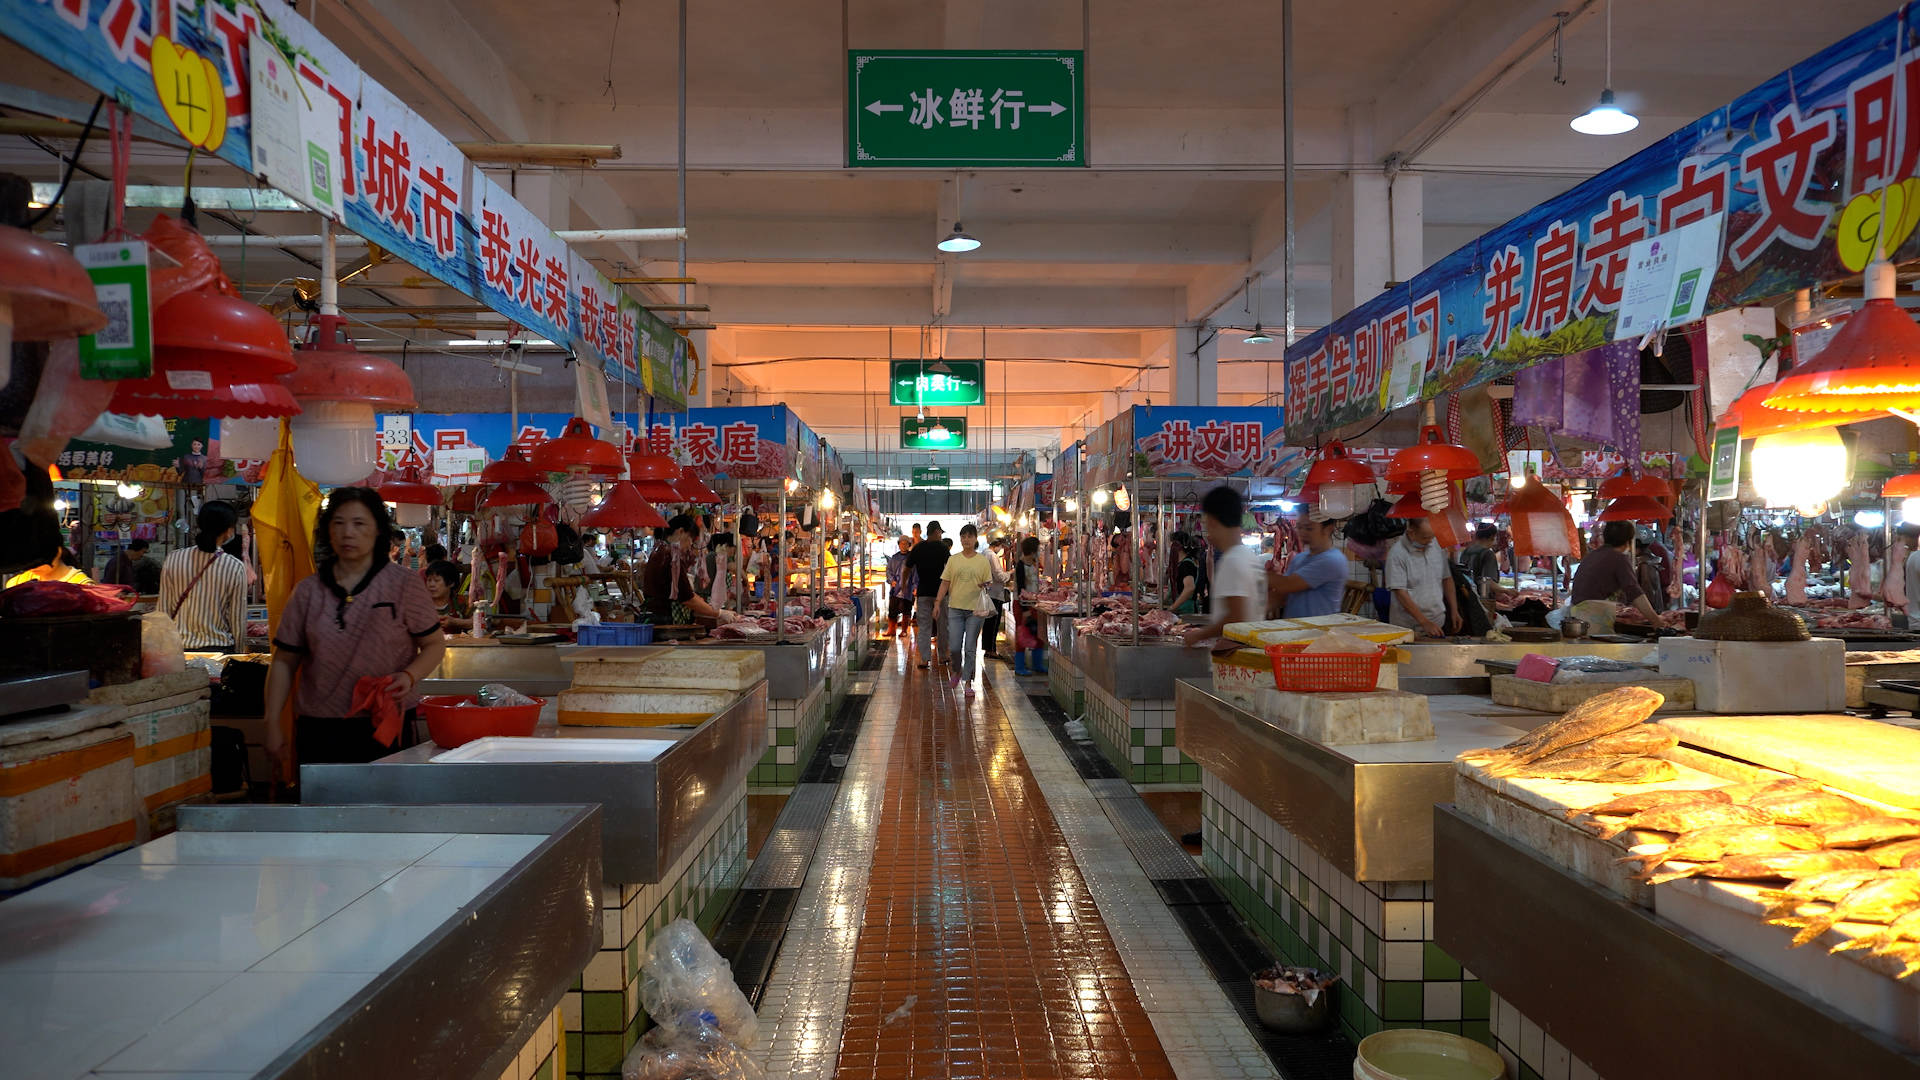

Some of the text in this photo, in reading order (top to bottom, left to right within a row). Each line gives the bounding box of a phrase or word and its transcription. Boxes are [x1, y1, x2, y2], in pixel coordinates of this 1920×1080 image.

[174, 69, 208, 133] 4
[909, 88, 1026, 130] 冰鲜行
[1857, 211, 1882, 268] 9
[481, 209, 569, 329] 我光荣
[580, 285, 637, 373] 我受益
[385, 429, 408, 445] 33
